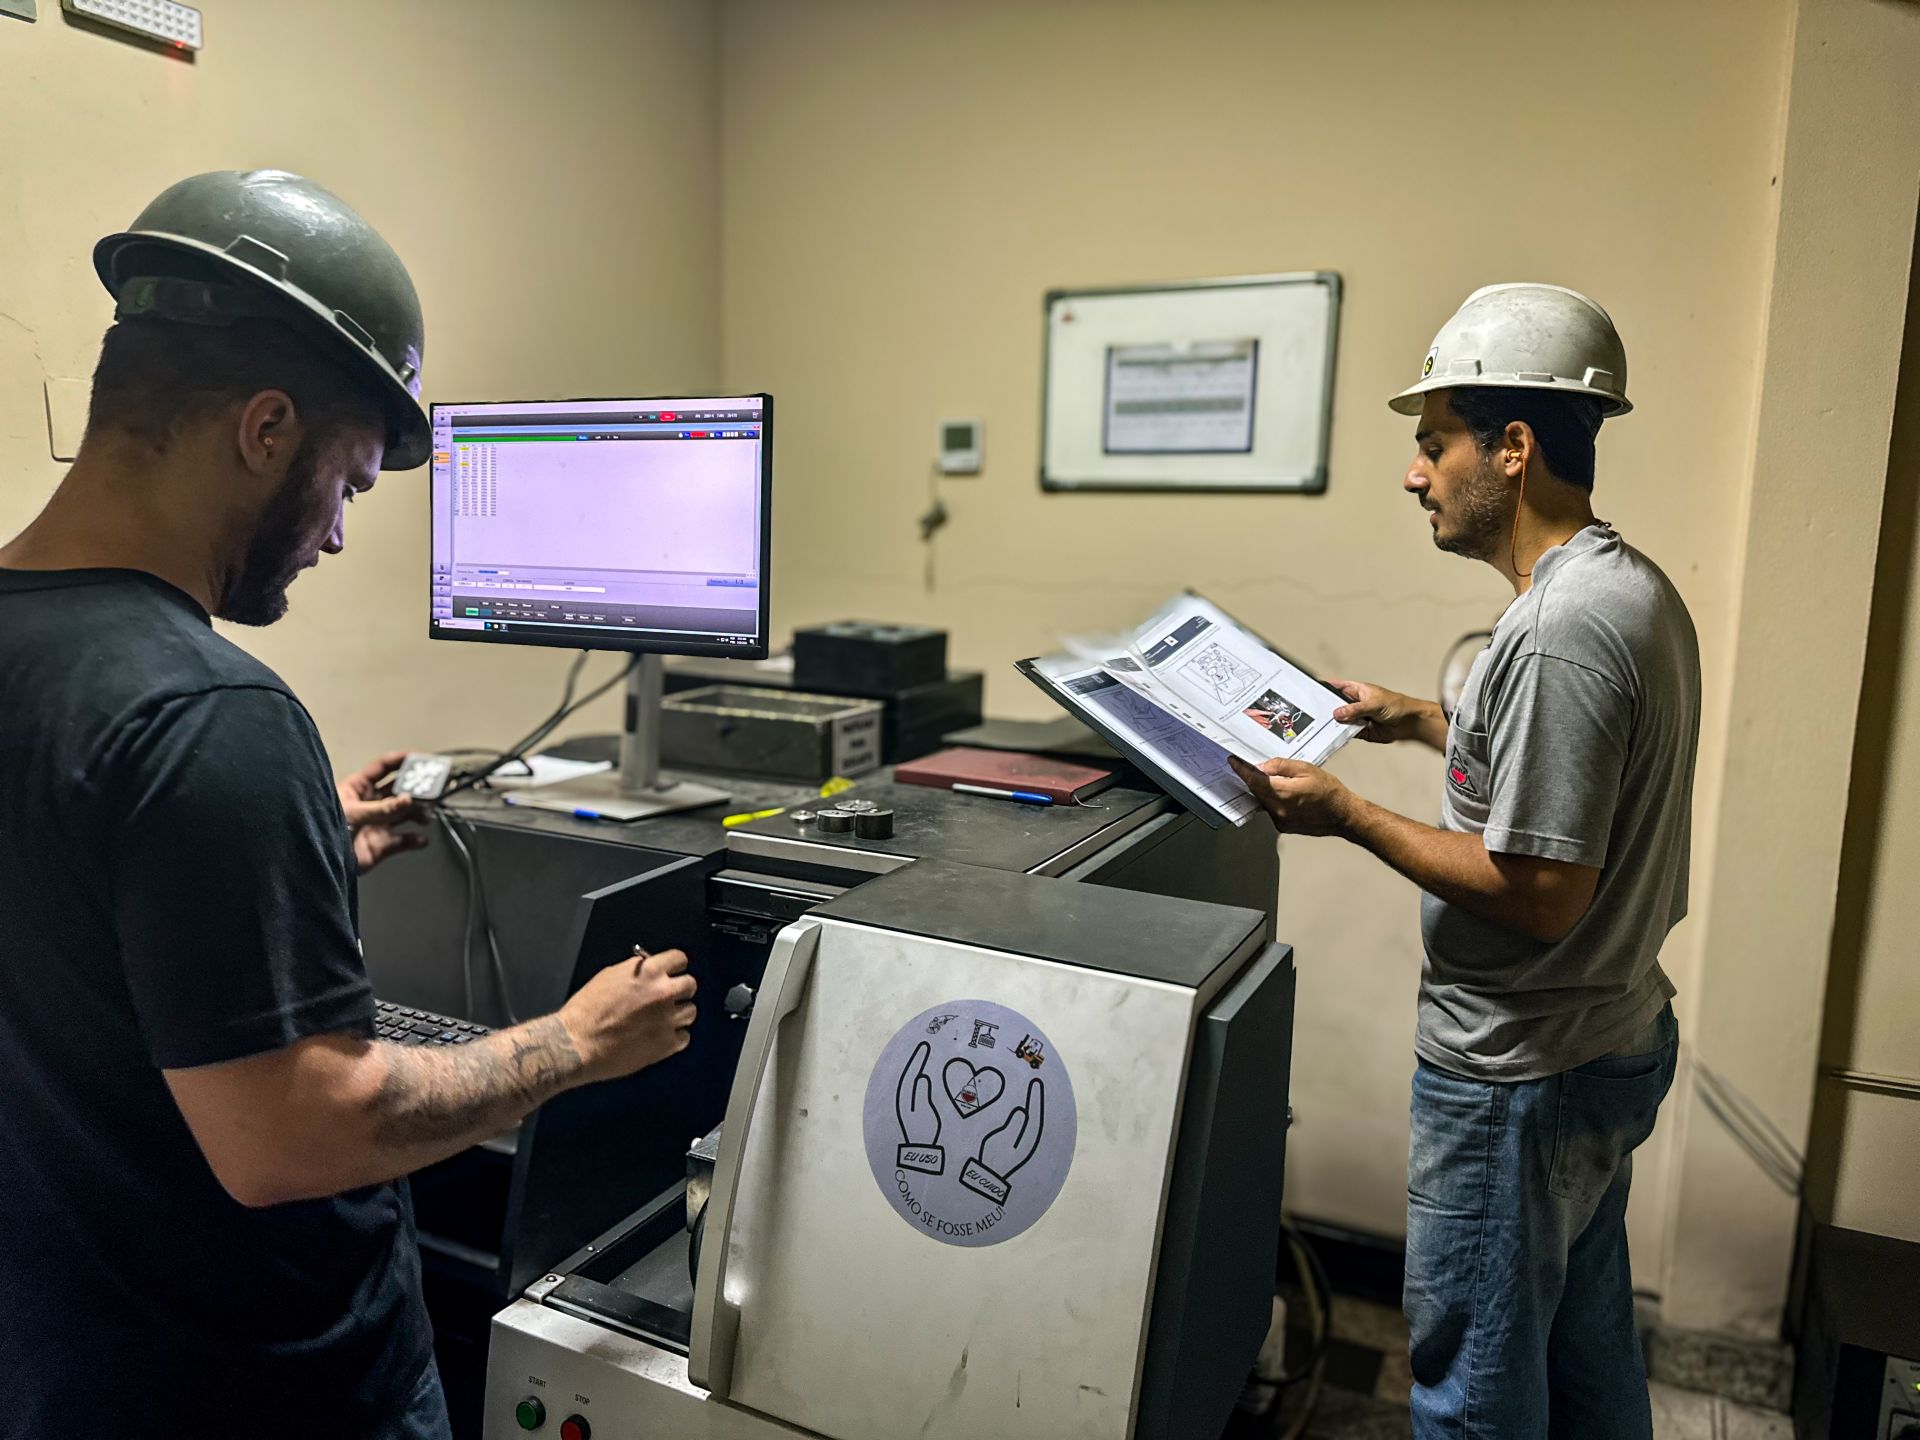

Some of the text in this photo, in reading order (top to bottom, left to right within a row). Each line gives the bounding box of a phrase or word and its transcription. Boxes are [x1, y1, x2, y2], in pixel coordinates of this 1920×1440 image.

[904, 1152, 938, 1164] EU USO
[966, 1169, 1005, 1198] EU CUIDO
[895, 1170, 1006, 1236] COMO SE FOSSE MEU!
[528, 1376, 546, 1388] START
[574, 1394, 590, 1406] STOP
